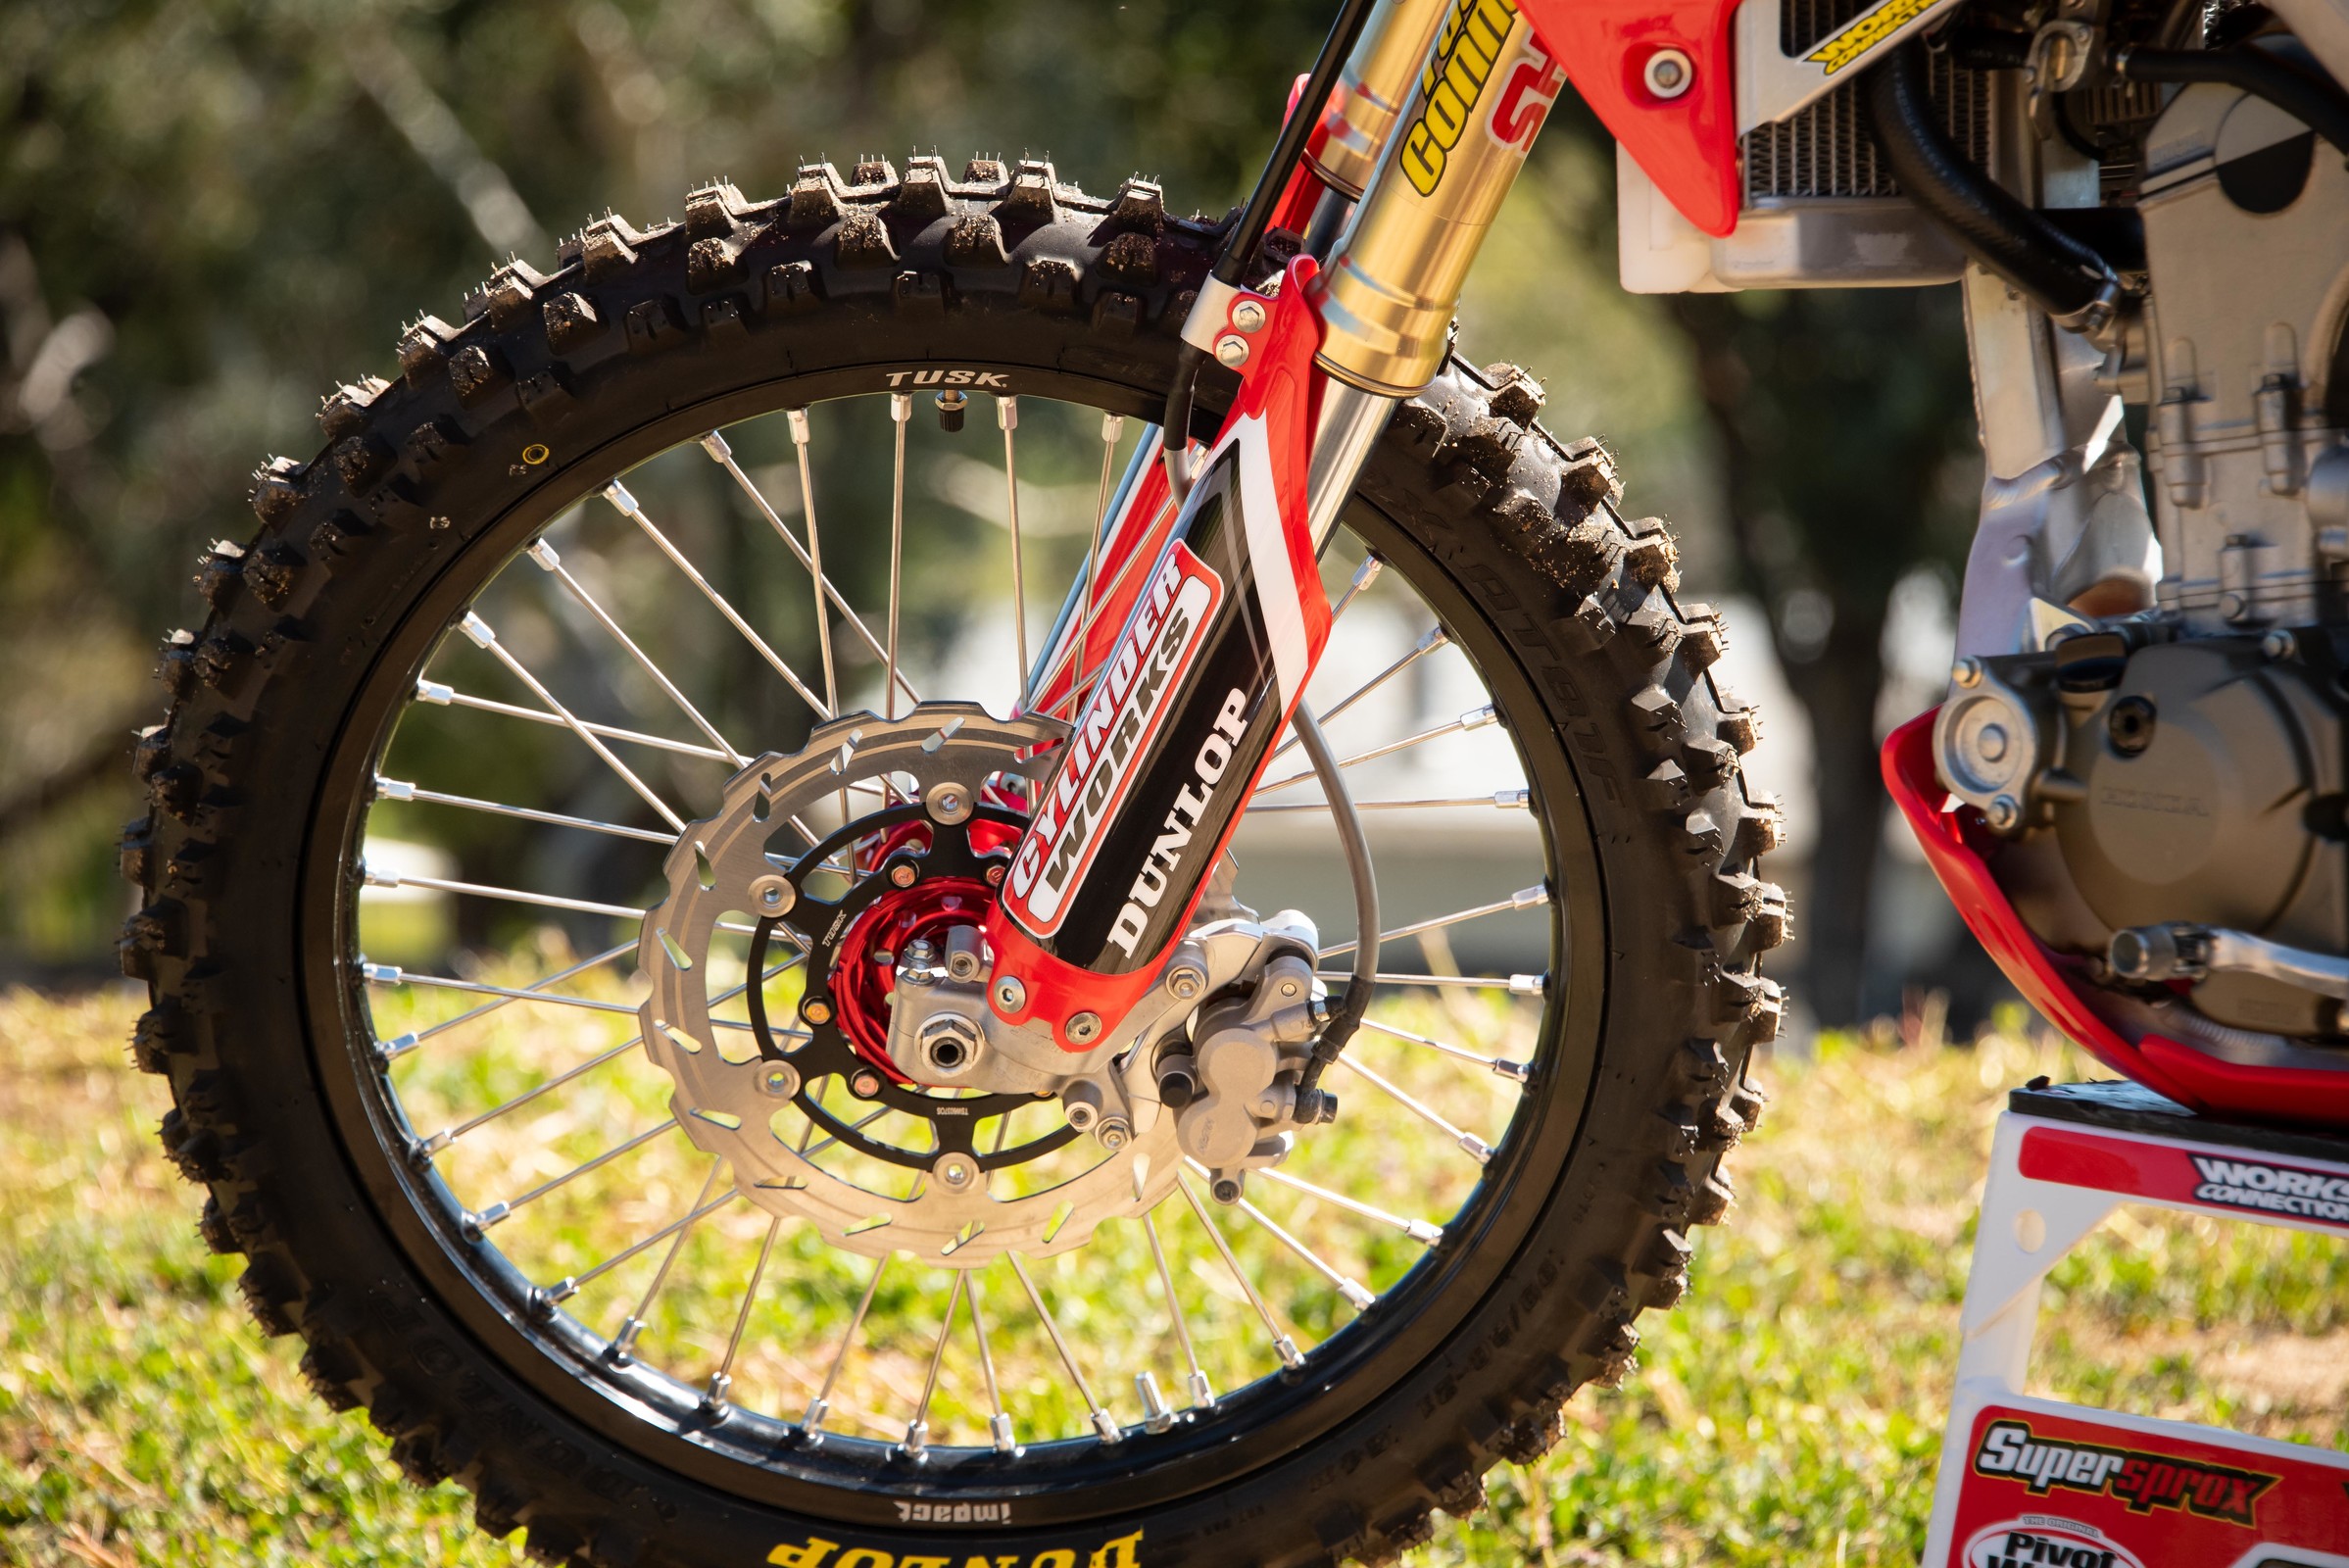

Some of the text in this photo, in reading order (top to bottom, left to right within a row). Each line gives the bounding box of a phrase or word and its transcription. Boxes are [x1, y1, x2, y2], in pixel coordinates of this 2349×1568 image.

[886, 370, 1010, 388] TUSK
[1014, 552, 1183, 898] CYLINDER
[1045, 607, 1190, 894] WORKS
[1107, 687, 1249, 959] DUNLOP
[822, 909, 847, 947] TUSK
[893, 1500, 1011, 1525] impact
[2023, 1516, 2100, 1539] THE ORIGINAL
[2005, 1531, 2118, 1568] Pivot
